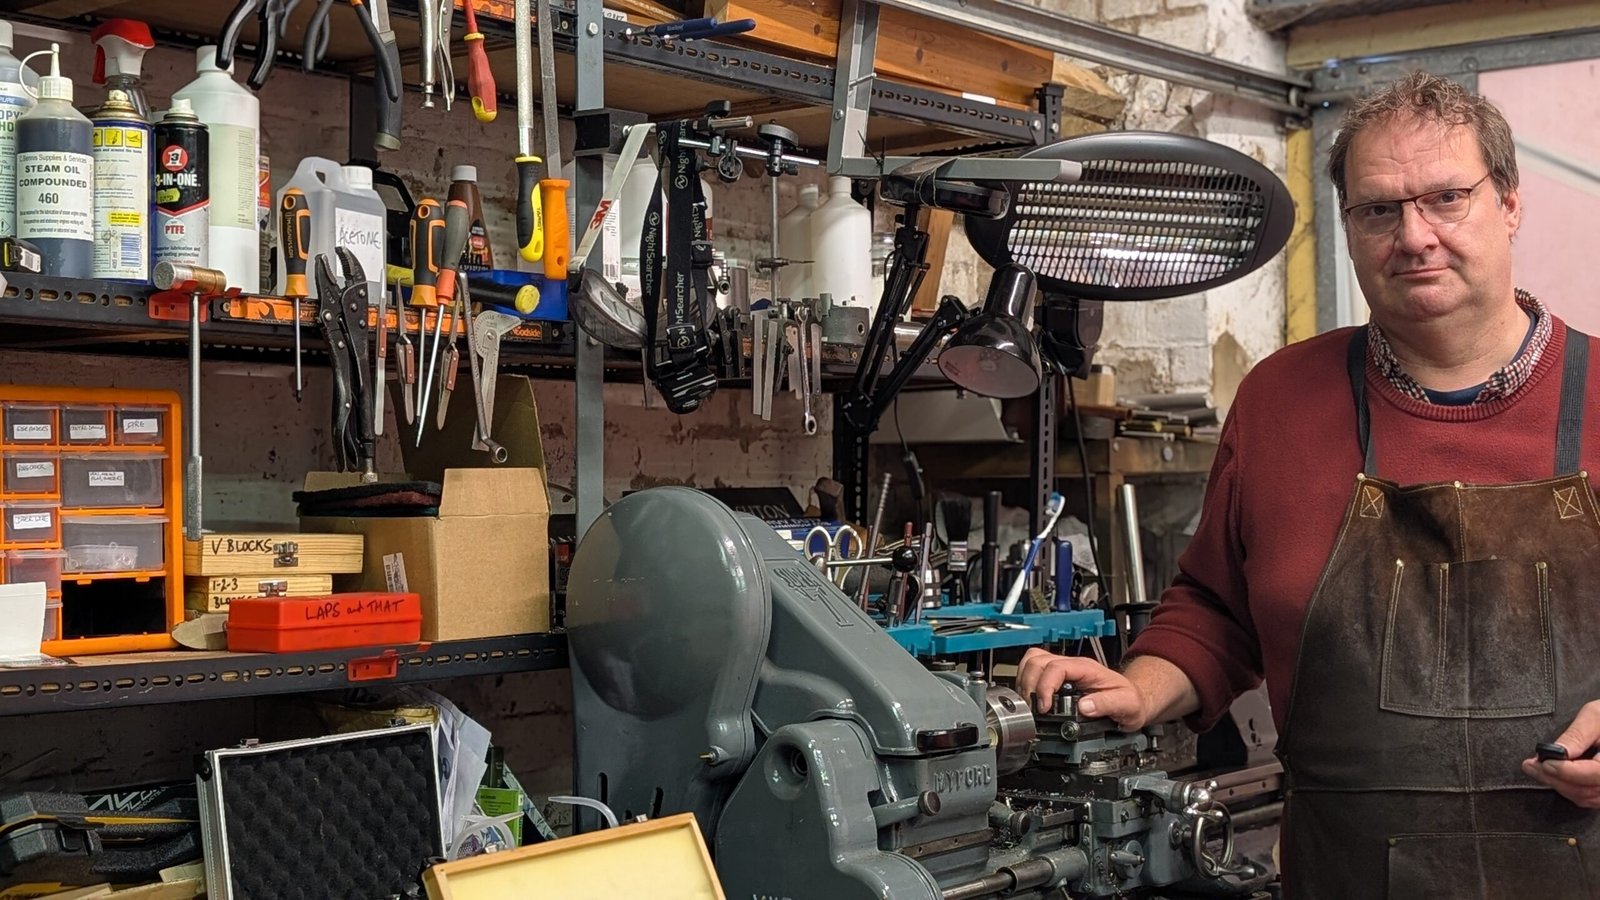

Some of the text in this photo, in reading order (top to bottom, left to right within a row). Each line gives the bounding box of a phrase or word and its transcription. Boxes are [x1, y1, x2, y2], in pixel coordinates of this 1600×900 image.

[25, 165, 81, 175] STEAM OIL
[19, 178, 88, 189] COMPOUNDED
[38, 192, 59, 204] 460
[165, 225, 185, 235] PTFE
[644, 227, 657, 296] NightSearcher
[211, 537, 273, 554] V BLOCKS
[212, 577, 239, 591] 1-2-3
[306, 602, 341, 621] LAPS
[367, 599, 404, 615] THAT
[933, 763, 991, 793] MYFORD
